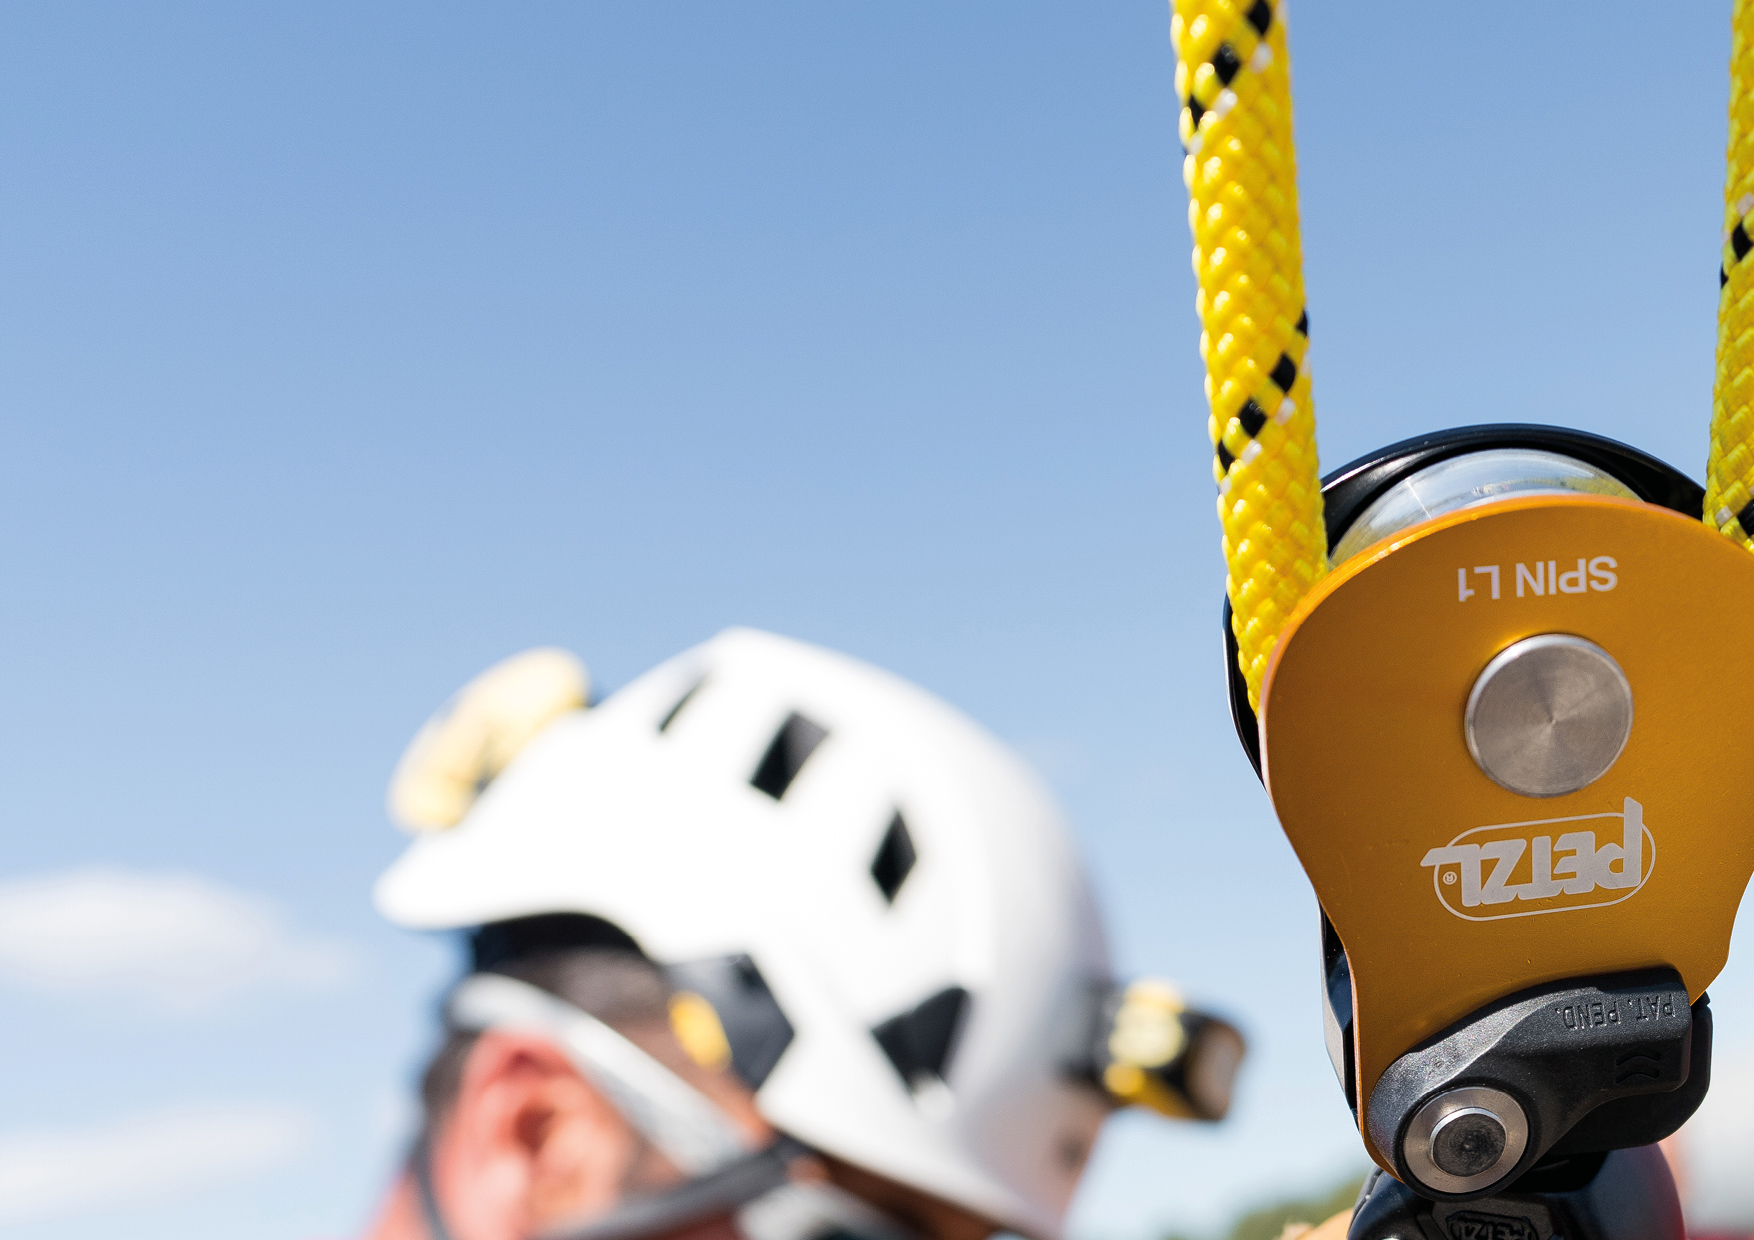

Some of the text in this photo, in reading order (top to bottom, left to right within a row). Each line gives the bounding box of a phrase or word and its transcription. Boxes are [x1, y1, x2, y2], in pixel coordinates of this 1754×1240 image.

[1457, 555, 1619, 602] SPIN L1
[1553, 993, 1678, 1032] PAT. PEND.
